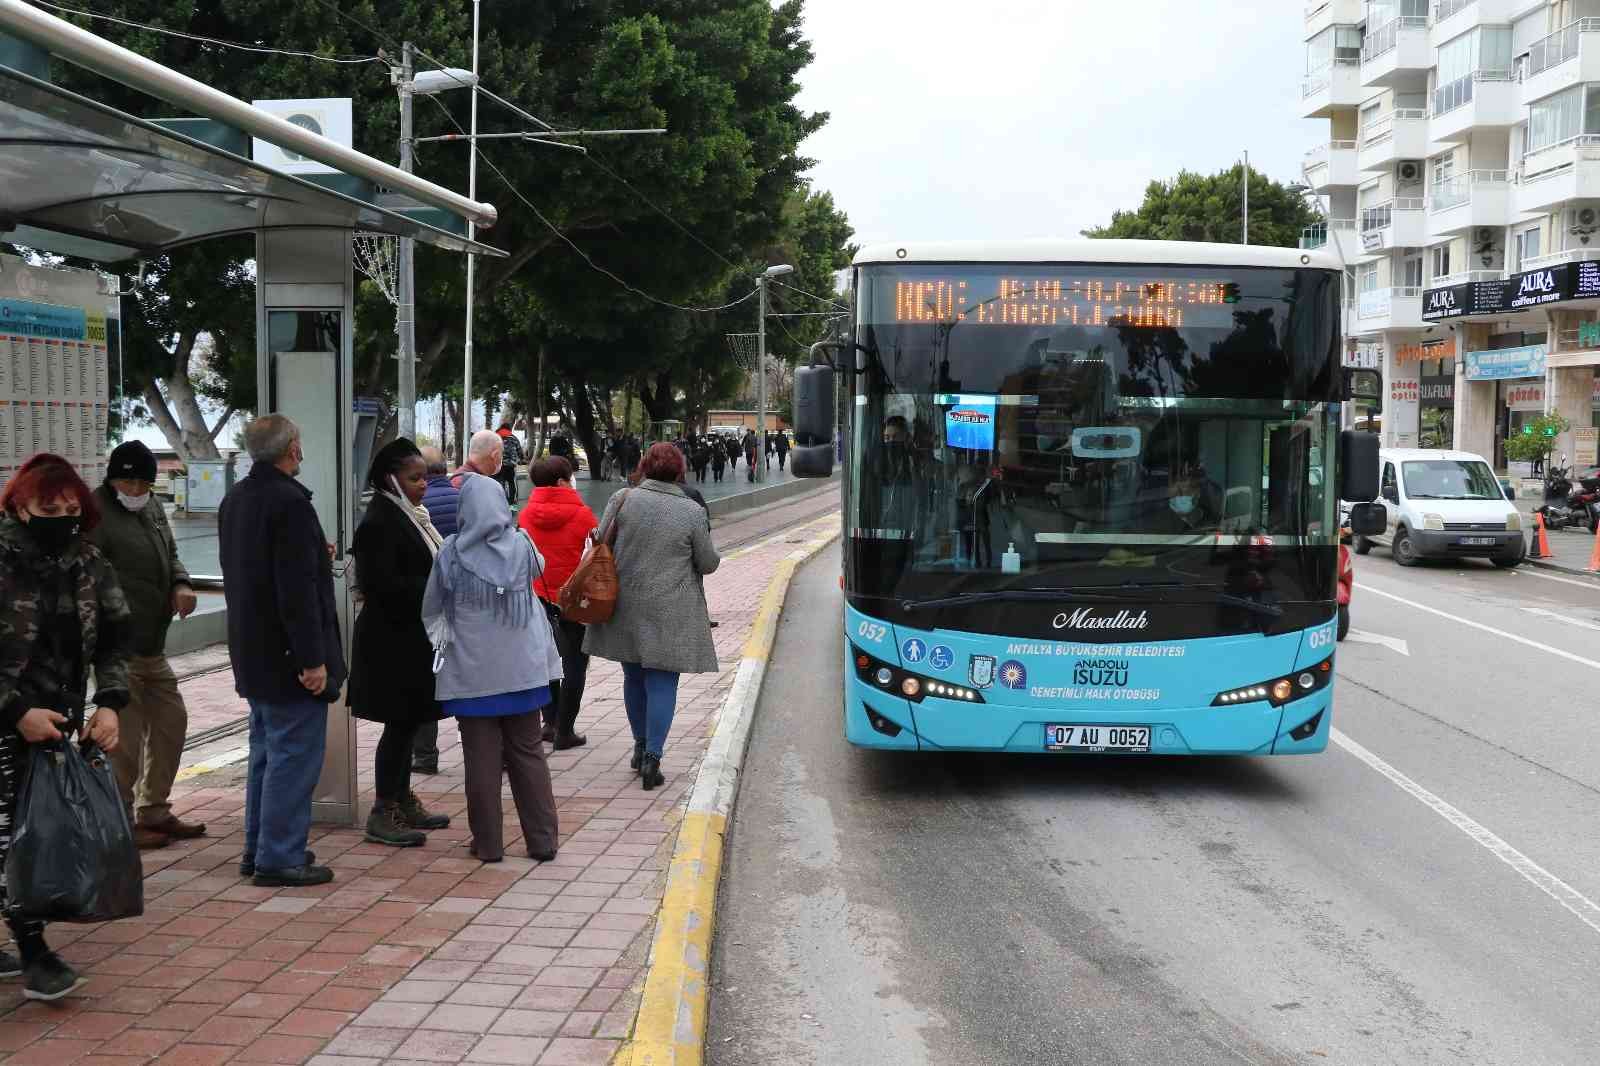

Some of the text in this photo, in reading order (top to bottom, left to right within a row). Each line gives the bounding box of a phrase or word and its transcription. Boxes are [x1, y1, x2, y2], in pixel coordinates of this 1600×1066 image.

[1518, 271, 1555, 295] AURA
[1428, 291, 1455, 310] AURA
[1512, 296, 1536, 307] coiffeur
[1542, 293, 1560, 302] more
[1392, 391, 1417, 401] optik
[1508, 387, 1540, 406] gözde
[858, 620, 887, 643] 052
[1006, 643, 1052, 655] ANTALYA
[1075, 659, 1128, 670] ANADOLU
[1072, 669, 1128, 687] ISUZU
[1085, 687, 1111, 699] HALK
[1113, 687, 1160, 700] OTOBÜSÜ
[1056, 727, 1147, 746] 07 AU 0052
